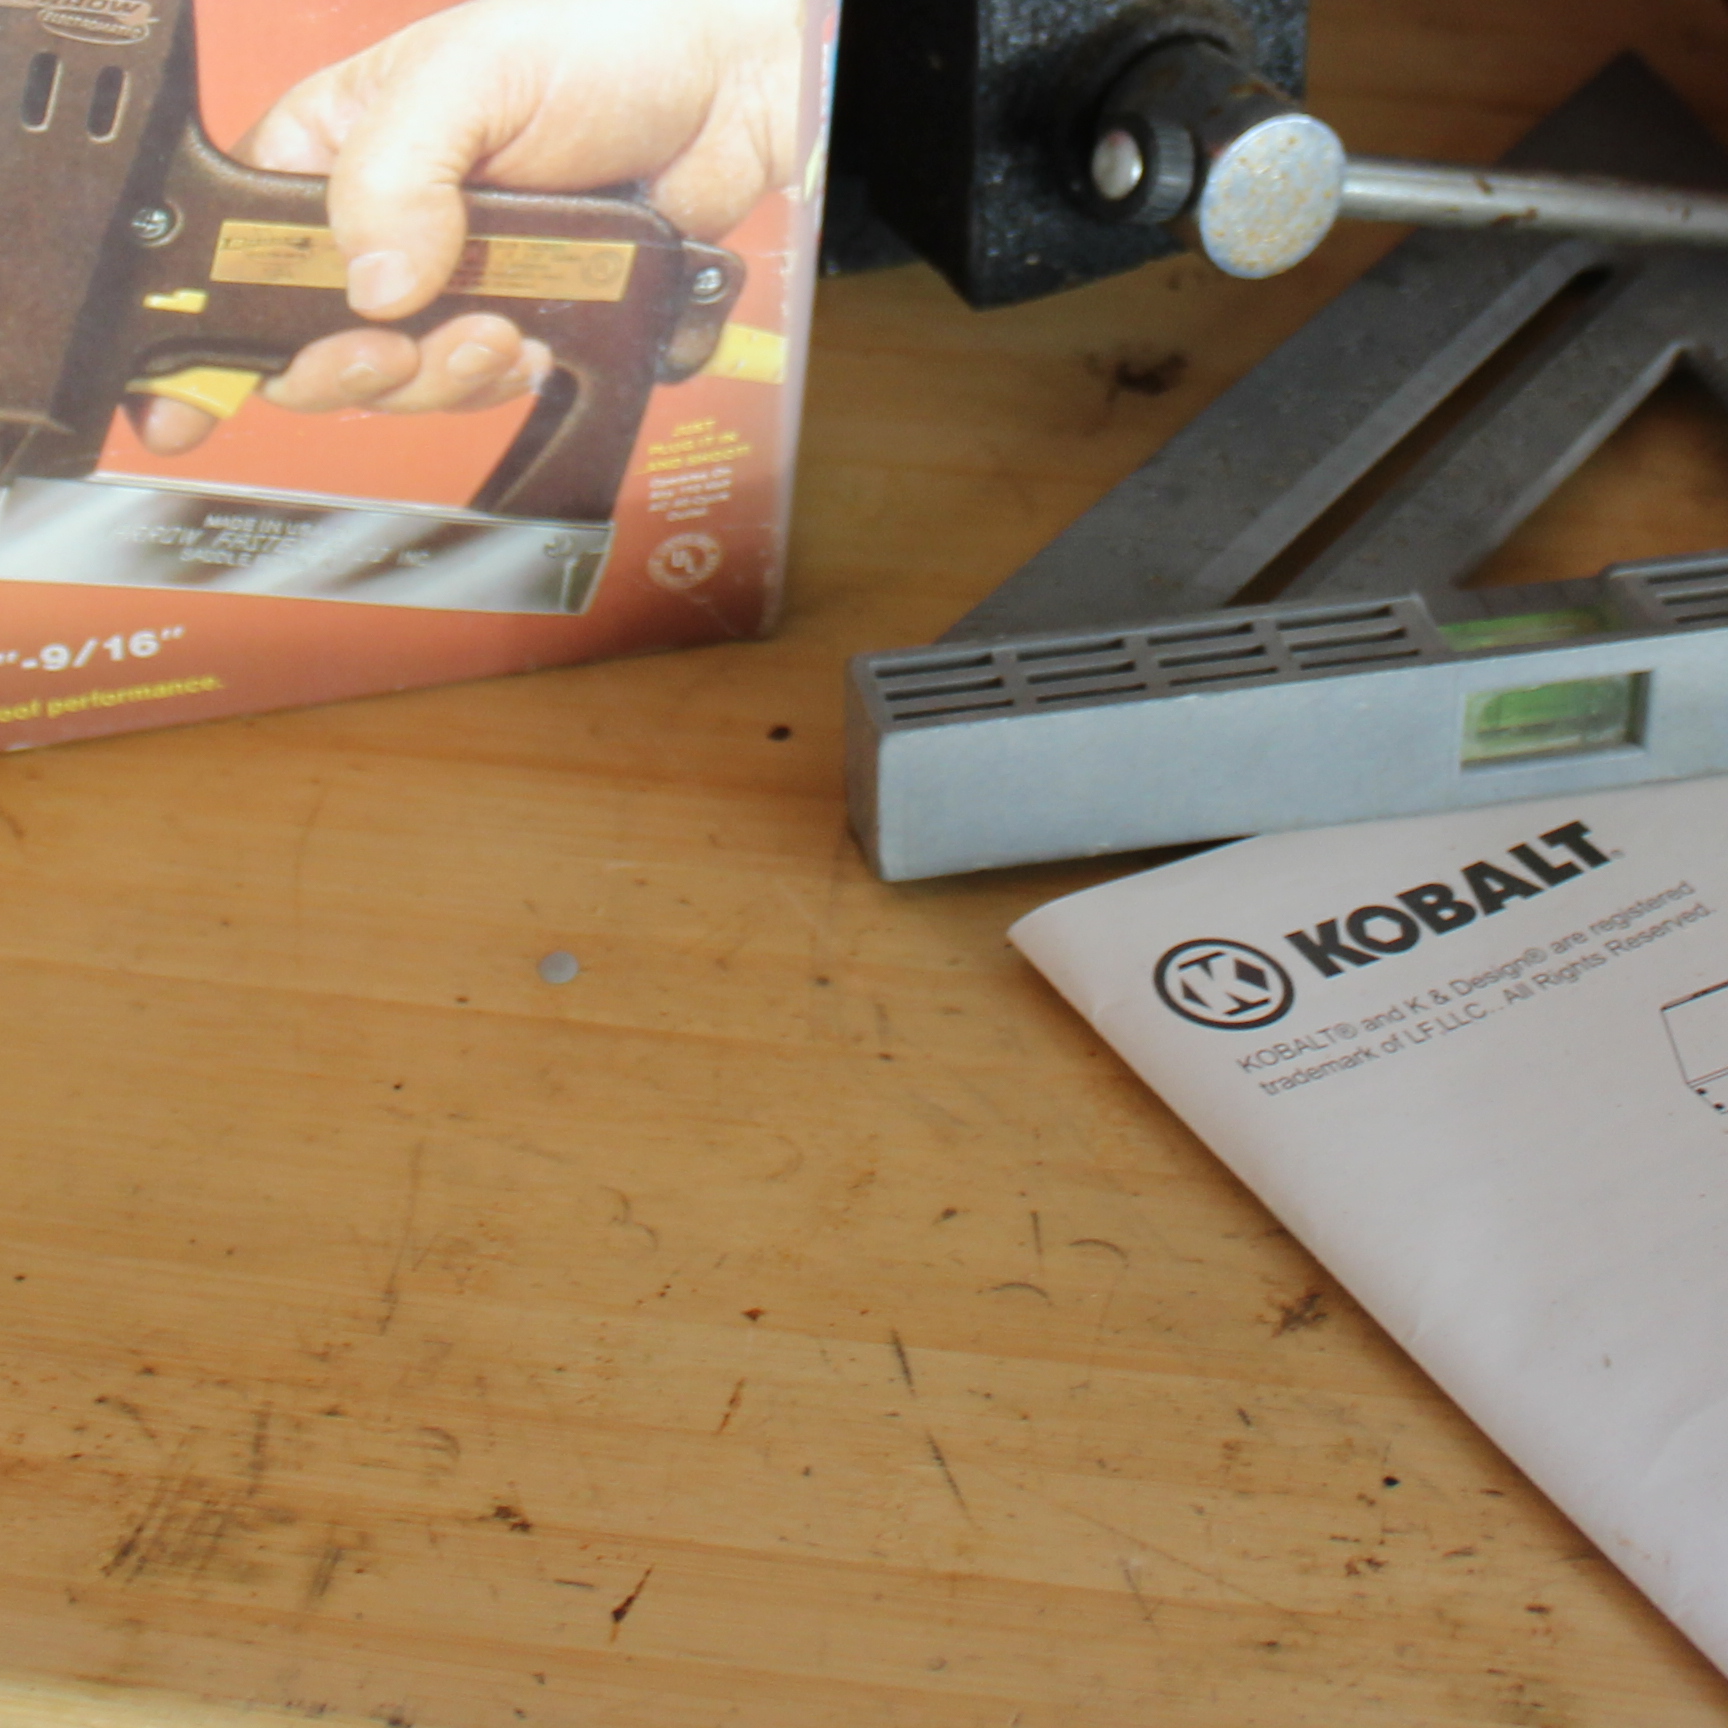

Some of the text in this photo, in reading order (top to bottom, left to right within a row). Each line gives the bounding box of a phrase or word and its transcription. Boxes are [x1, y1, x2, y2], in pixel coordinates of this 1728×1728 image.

[1283, 819, 1613, 980] KOBALT
[1360, 1005, 1407, 1033] and
[1403, 995, 1431, 1015] K
[1427, 988, 1452, 1006] &
[1549, 929, 1589, 956] are
[1589, 879, 1697, 936] registered
[1259, 1046, 1381, 1097] trademark
[1380, 1033, 1407, 1055] of
[1531, 951, 1608, 991] Rights
